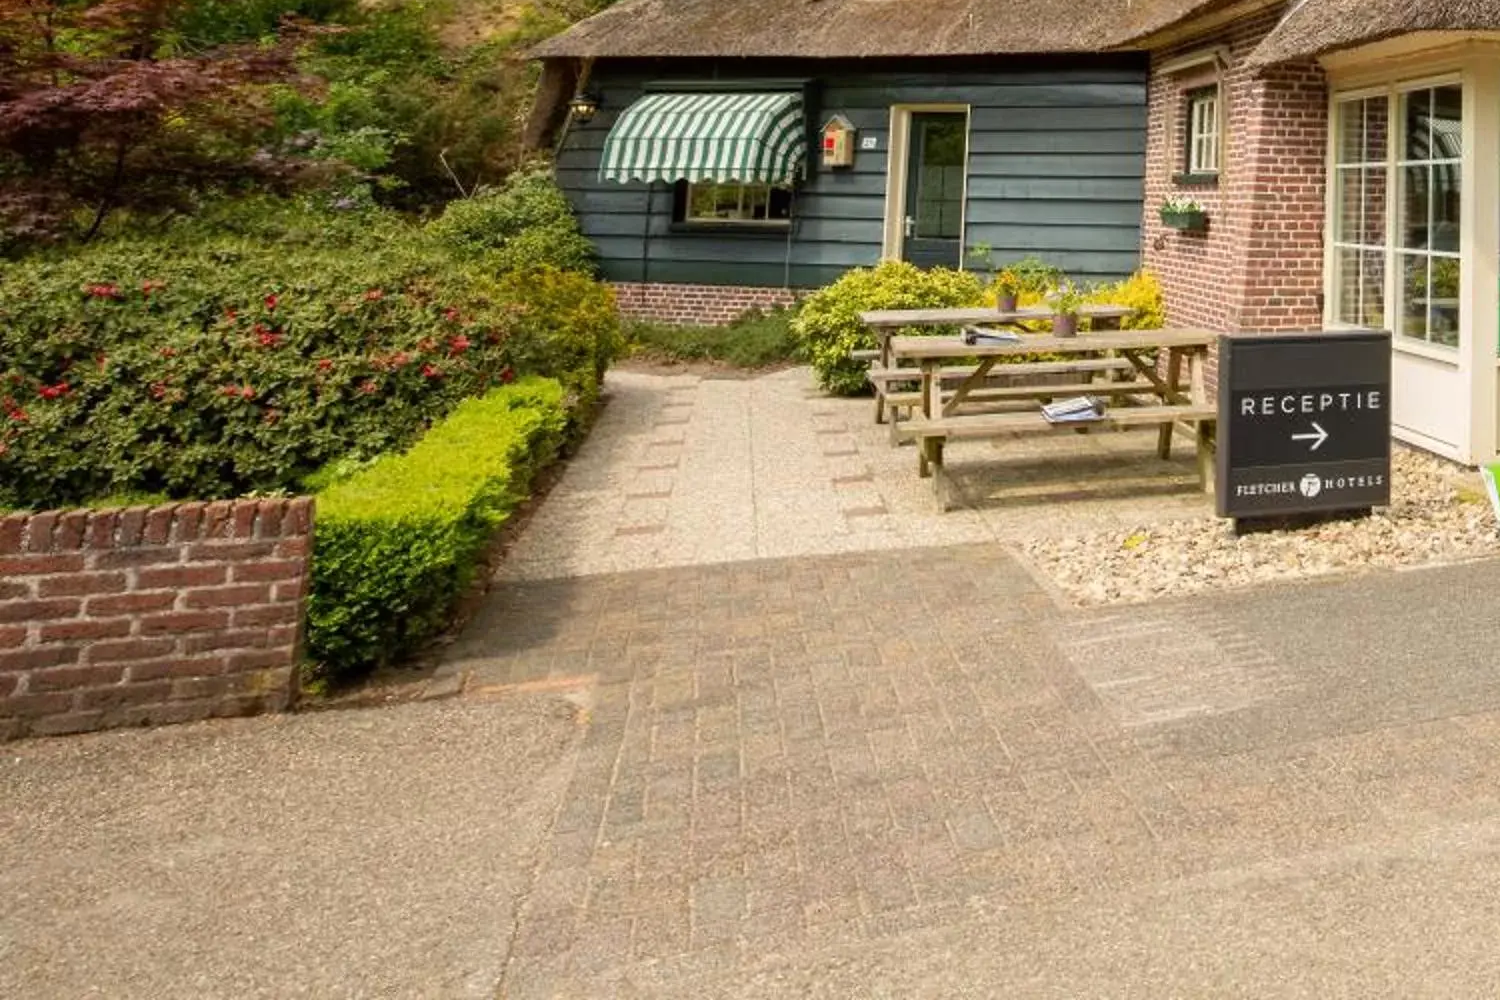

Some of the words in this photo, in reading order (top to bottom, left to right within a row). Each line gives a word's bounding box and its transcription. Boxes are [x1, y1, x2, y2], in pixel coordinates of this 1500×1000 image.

[1240, 391, 1381, 416] RECEPTIE
[1236, 481, 1296, 497] FLETCHER
[1324, 475, 1384, 489] HOTELS
